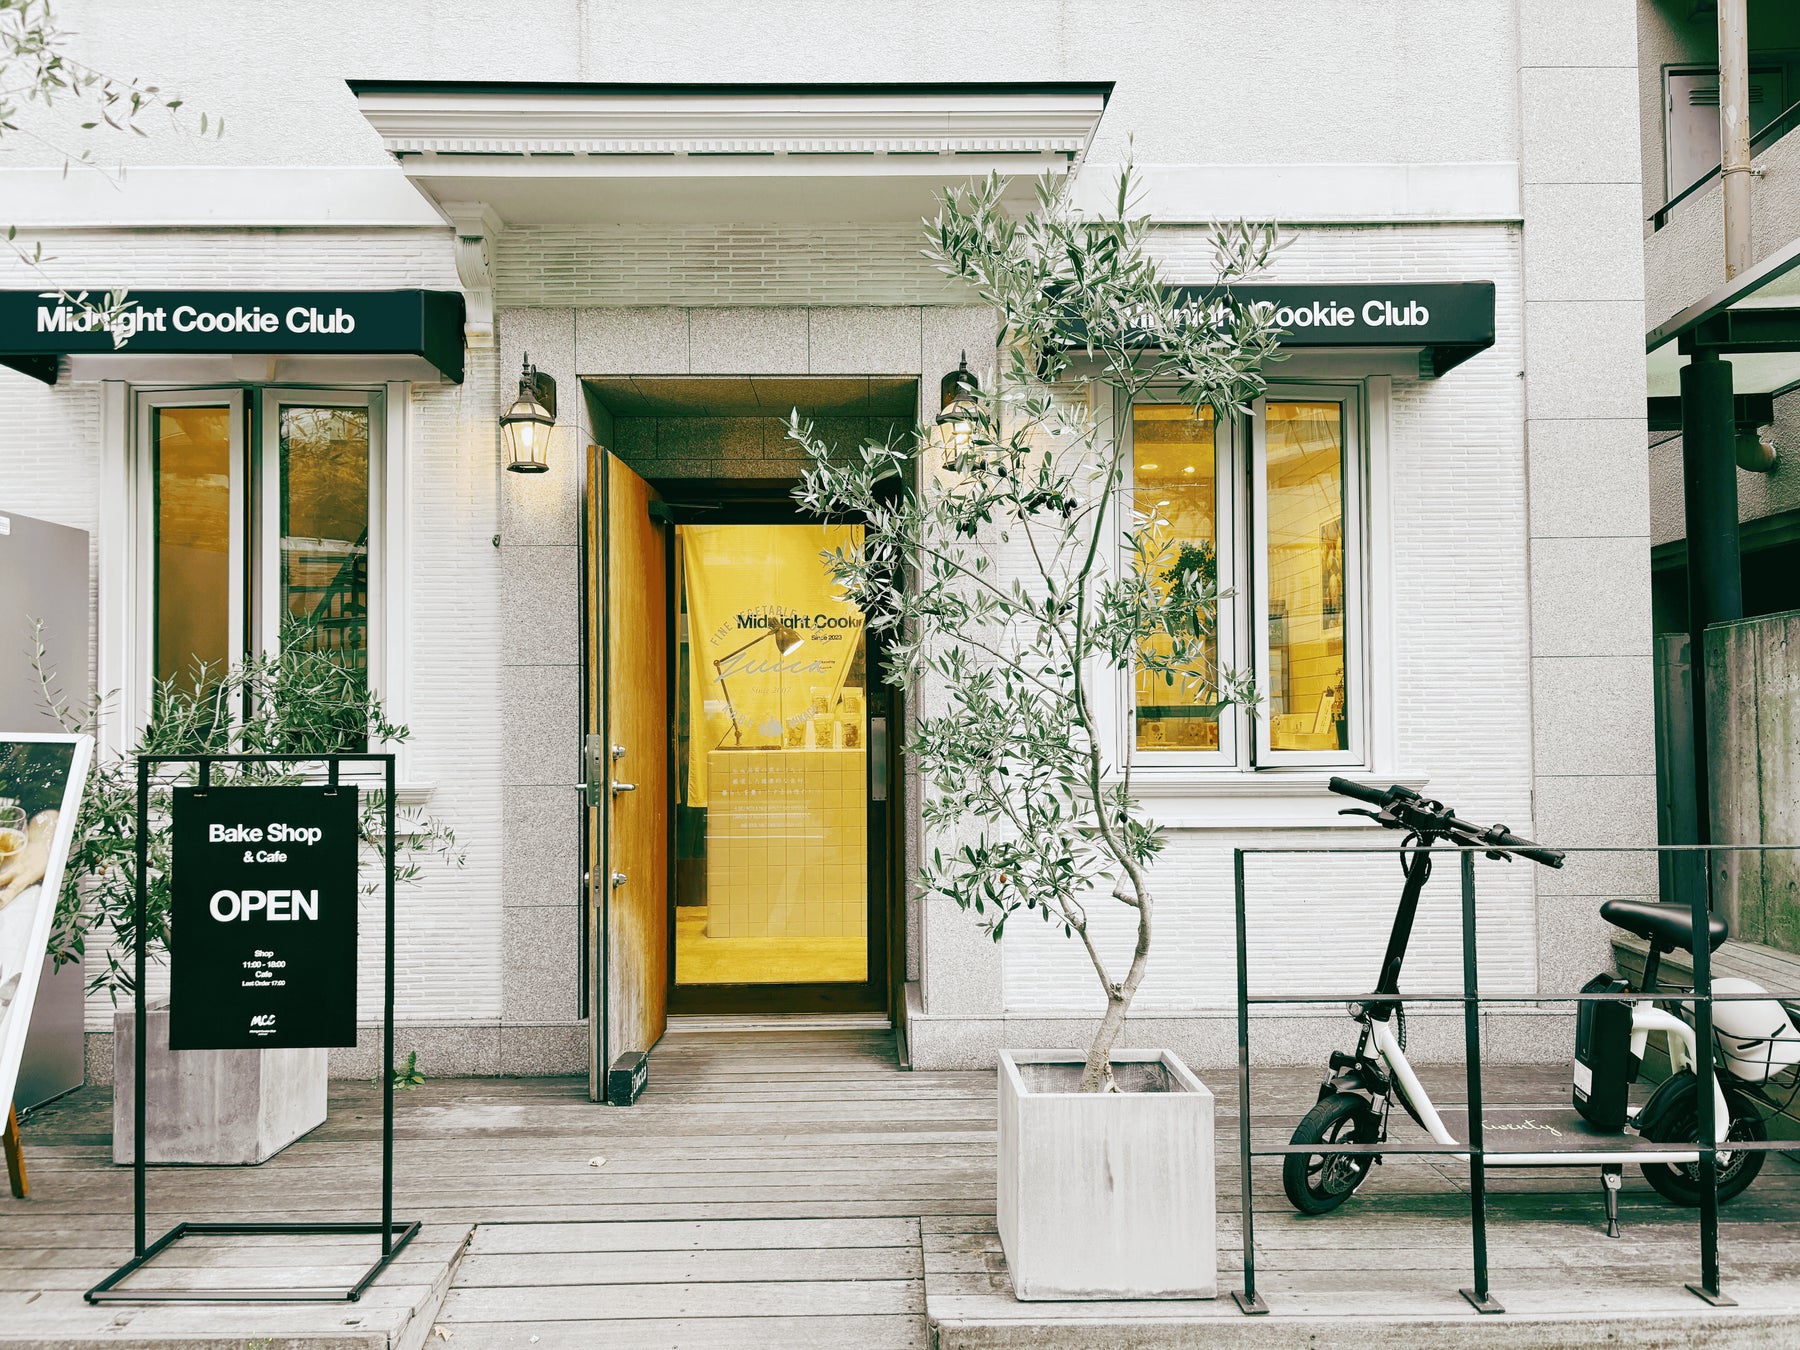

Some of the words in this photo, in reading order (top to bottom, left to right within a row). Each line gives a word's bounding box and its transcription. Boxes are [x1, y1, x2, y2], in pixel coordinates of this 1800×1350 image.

[173, 306, 279, 333] Cookie
[286, 307, 356, 334] Club
[1362, 300, 1430, 327] Club
[737, 614, 810, 630] Midight
[209, 824, 263, 843] Bake
[267, 823, 322, 845] Shop
[243, 851, 254, 863] &
[256, 851, 288, 863] Cafe
[210, 890, 319, 922] OPEN
[254, 950, 274, 958] Shop
[250, 1014, 276, 1026] MCC
